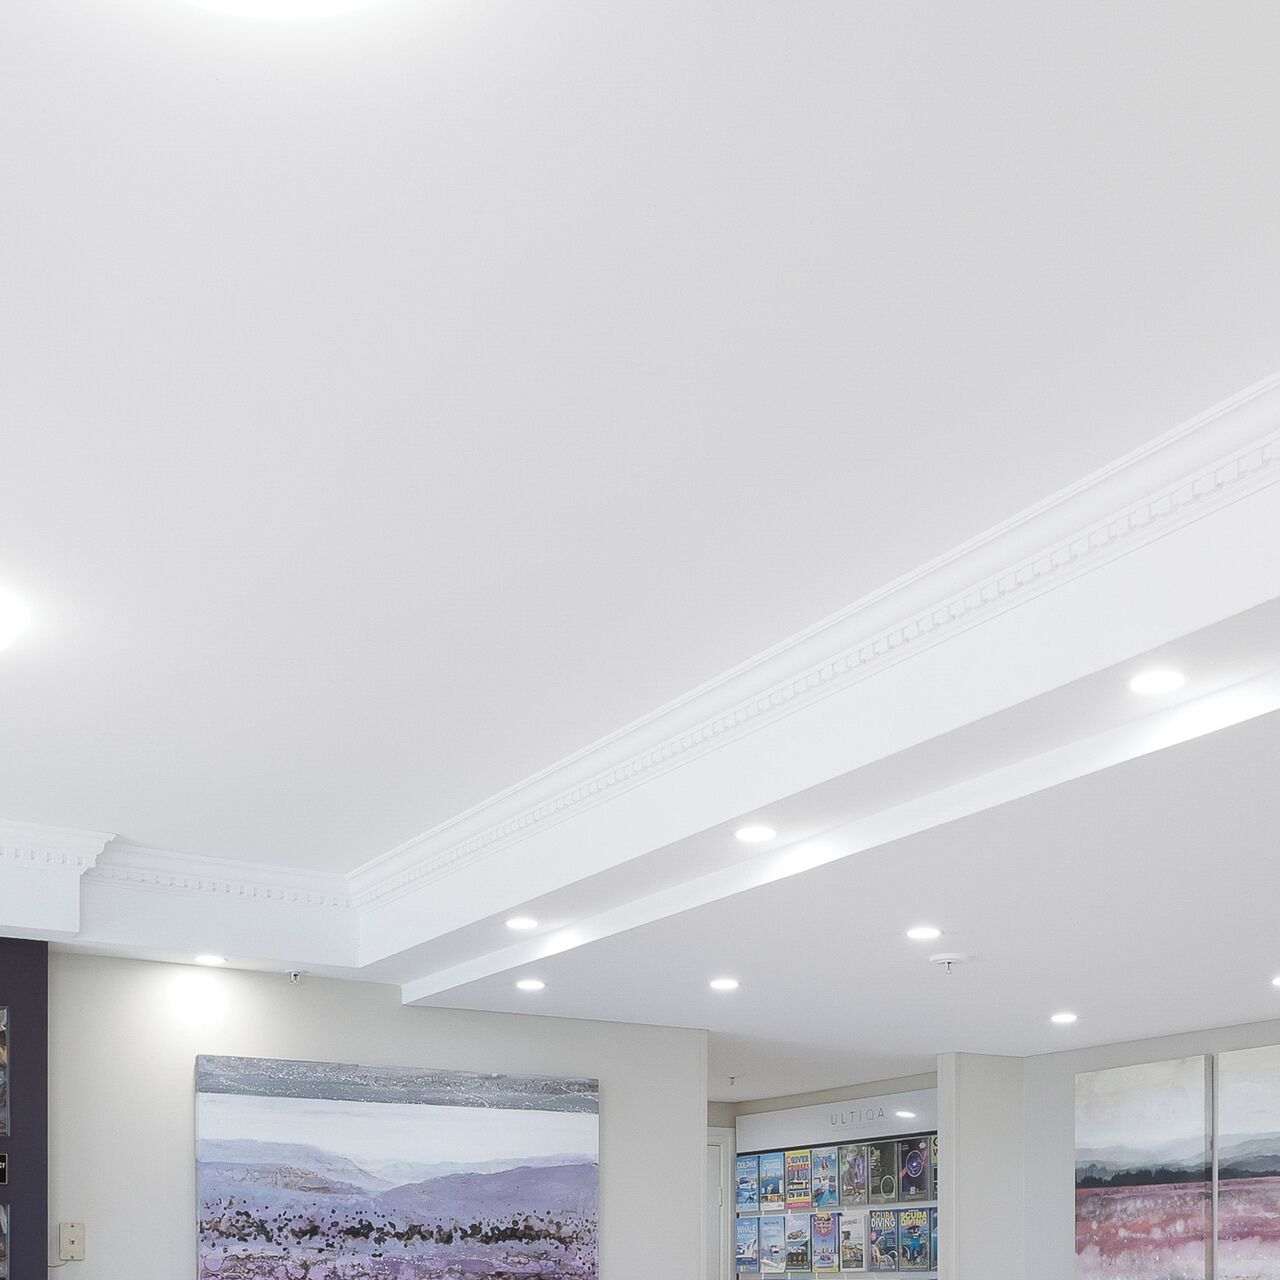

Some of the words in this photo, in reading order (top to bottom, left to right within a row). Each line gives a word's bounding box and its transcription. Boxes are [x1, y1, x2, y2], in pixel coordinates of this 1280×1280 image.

[830, 1107, 885, 1126] ULTIQA
[871, 1211, 894, 1219] SCUBA
[900, 1211, 927, 1219] SCUBA
[871, 1218, 896, 1228] DIVING
